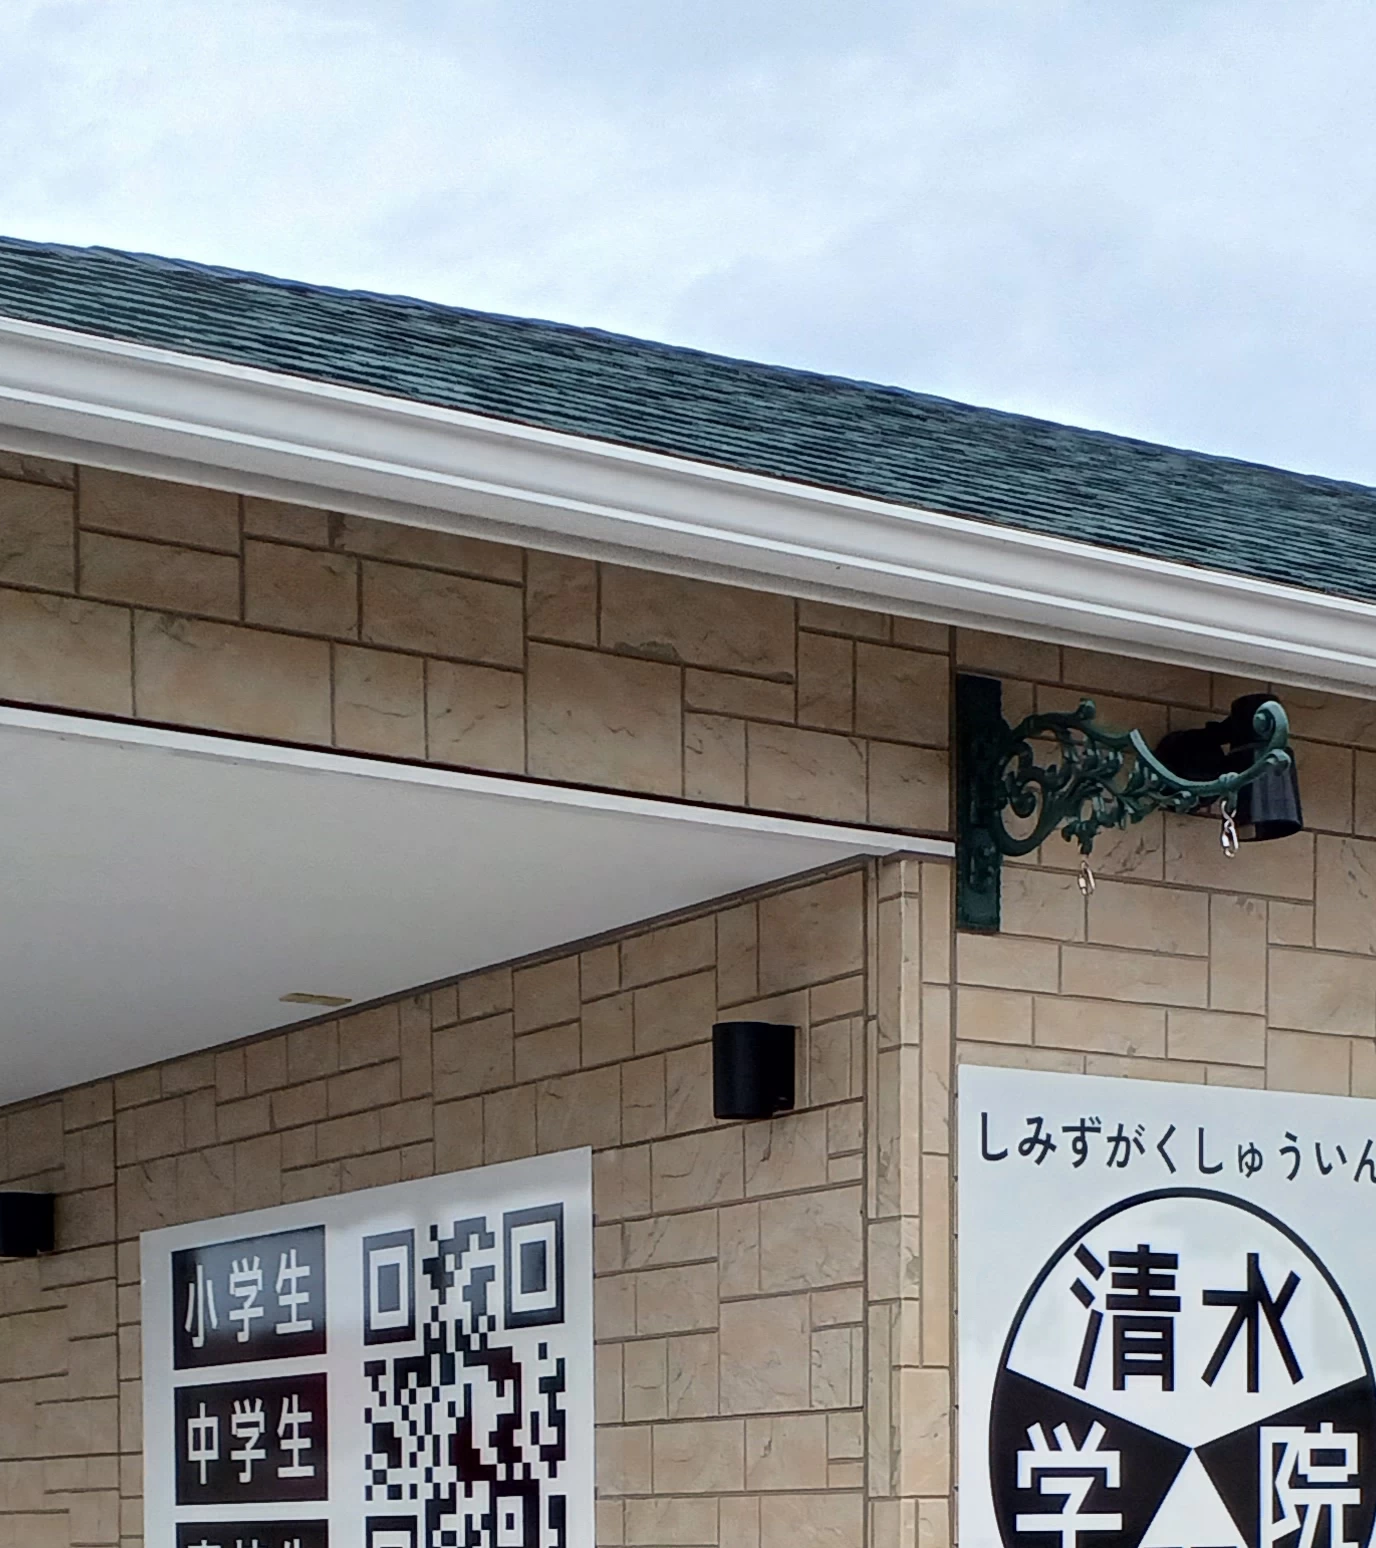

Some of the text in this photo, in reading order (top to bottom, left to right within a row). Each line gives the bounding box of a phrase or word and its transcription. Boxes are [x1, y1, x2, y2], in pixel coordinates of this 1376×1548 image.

[184, 1248, 313, 1349] 小学生
[1069, 1243, 1304, 1394] 清水
[187, 1393, 315, 1486] 中学生
